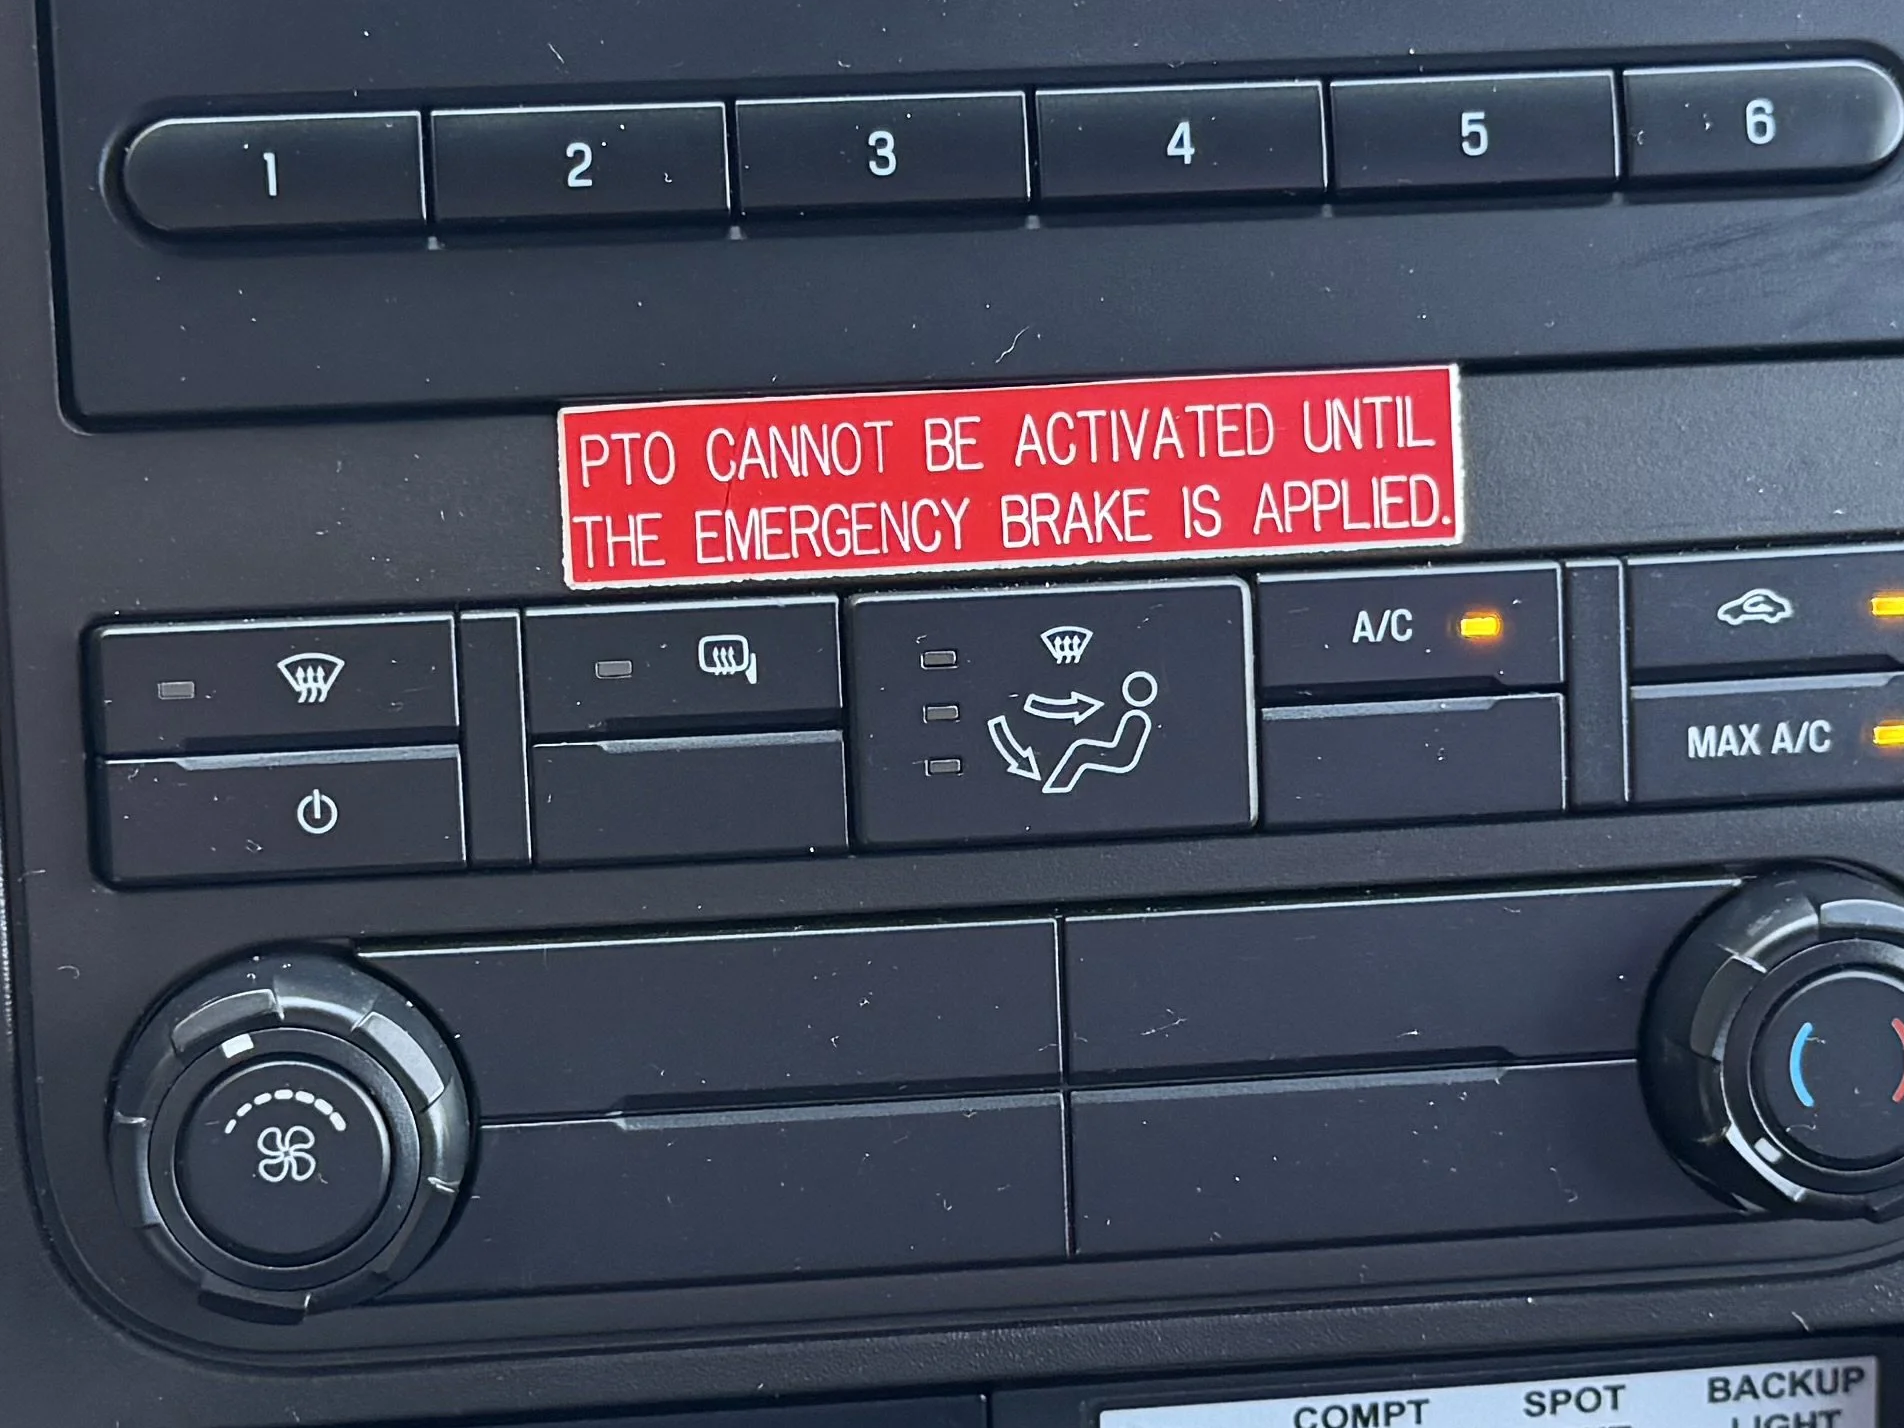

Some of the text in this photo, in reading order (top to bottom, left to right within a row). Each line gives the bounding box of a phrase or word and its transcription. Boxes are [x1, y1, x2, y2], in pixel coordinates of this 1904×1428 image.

[1165, 119, 1197, 166] 4
[1460, 110, 1490, 157] 5
[1744, 98, 1777, 146] 6
[262, 151, 279, 198] 1
[565, 141, 594, 189] 2
[867, 129, 898, 177] 3
[579, 394, 1437, 489] PTO CANNOT BE ACTIVATED UNTIL
[572, 473, 1455, 569] THE EMERGENCY BRAKE IS APPLIED.
[1351, 608, 1413, 645] A/C
[1686, 719, 1833, 760] MAX A/C
[1522, 1383, 1628, 1419] SPOT
[1706, 1366, 1866, 1405] BACKUP
